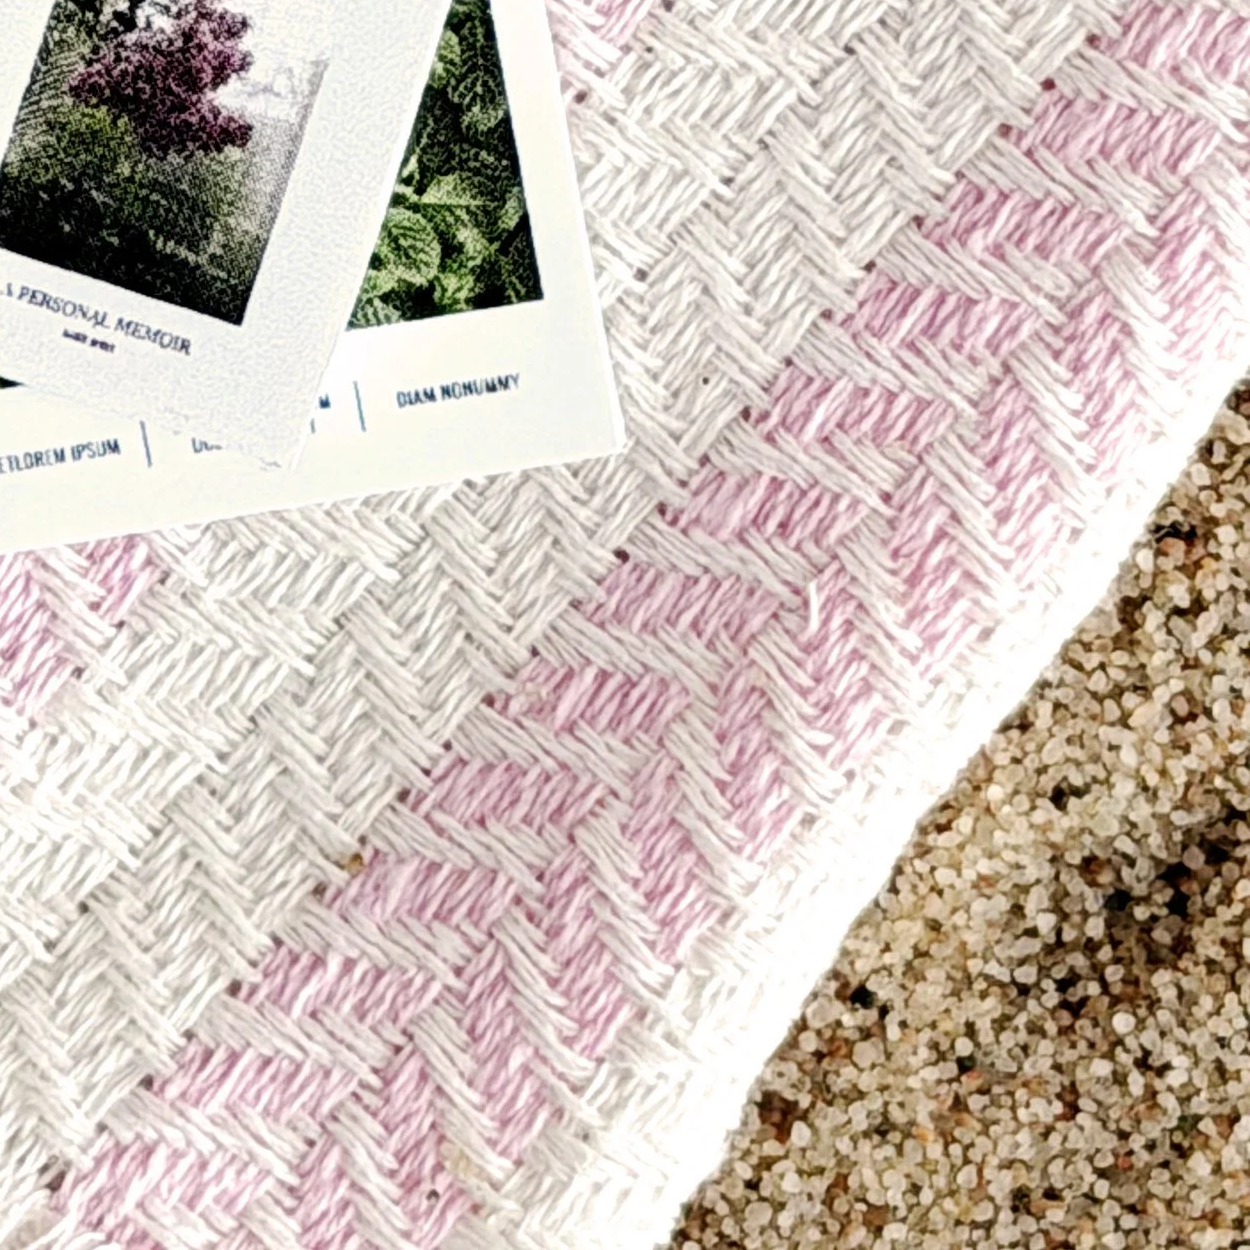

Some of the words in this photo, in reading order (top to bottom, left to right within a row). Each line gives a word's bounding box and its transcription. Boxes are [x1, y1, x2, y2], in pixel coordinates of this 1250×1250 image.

[17, 285, 110, 330] PERSONAL
[113, 316, 192, 356] MEMOIR
[396, 386, 437, 409] DIAM
[439, 371, 520, 401] NONUMMY
[70, 438, 121, 462] IPSUM
